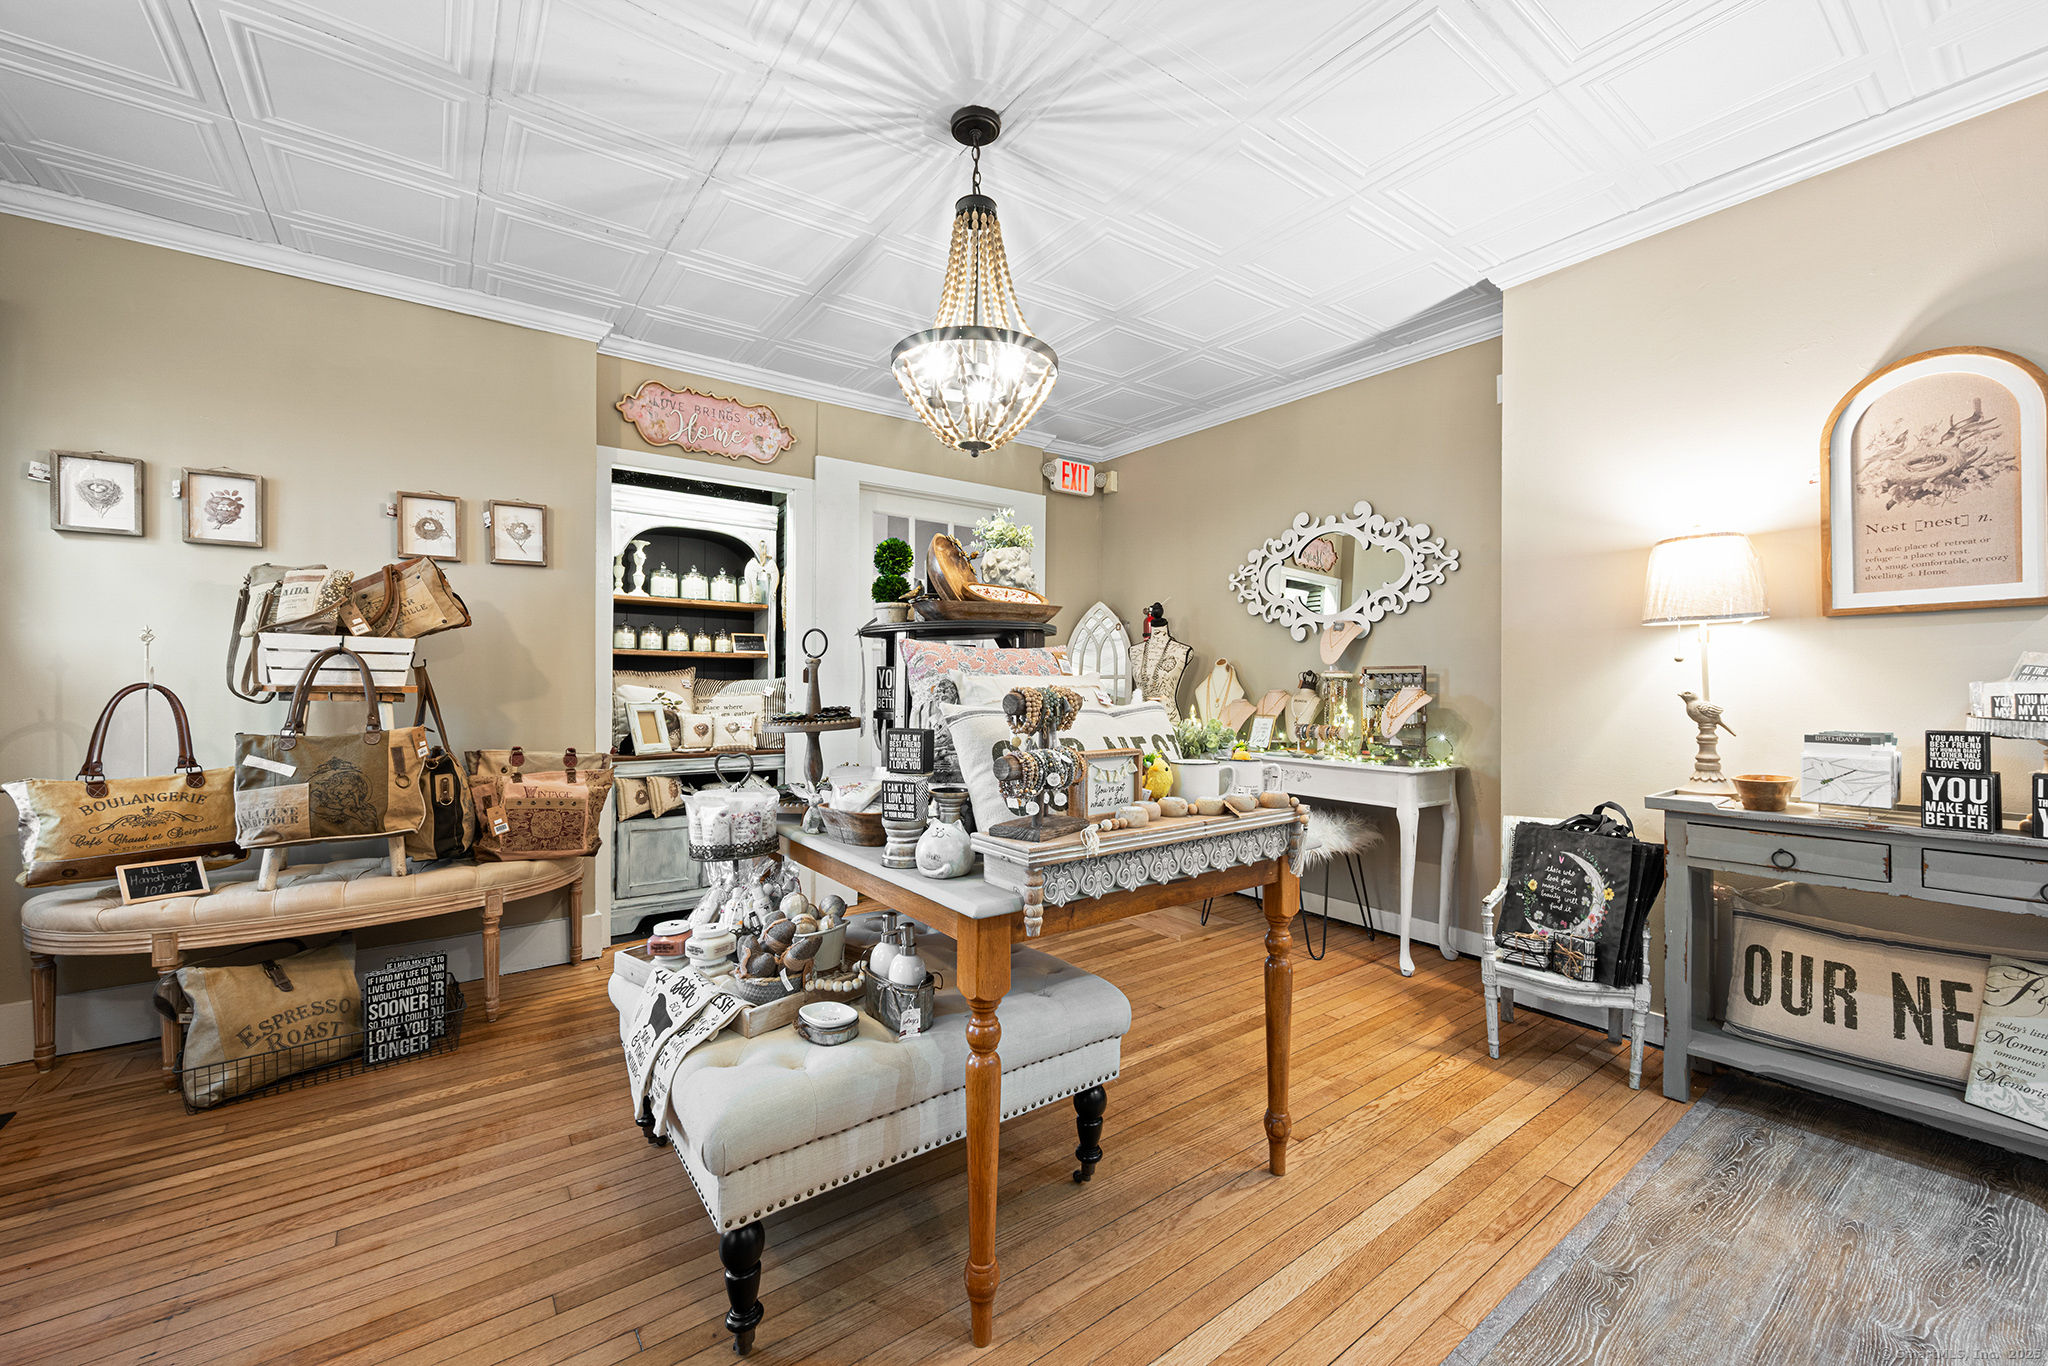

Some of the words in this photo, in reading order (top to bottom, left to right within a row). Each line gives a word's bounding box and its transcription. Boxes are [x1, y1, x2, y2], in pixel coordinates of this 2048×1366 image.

[653, 397, 685, 412] LOVE
[694, 405, 740, 423] BRINGS
[749, 417, 763, 427] US
[669, 410, 746, 447] Home
[1062, 461, 1090, 492] EXIT
[1866, 522, 1907, 535] Nest
[1915, 514, 1969, 532] [nest]
[1978, 514, 1992, 522] n.
[1904, 543, 1928, 552] place
[1945, 538, 1977, 547] retreat
[1910, 552, 1935, 560] place
[1911, 557, 1970, 568] comfortable,
[1986, 554, 2009, 563] cozy
[878, 698, 894, 708] BETT
[2018, 695, 2037, 705] YOU
[2018, 705, 2034, 715] MY
[893, 761, 908, 769] LOVE
[909, 761, 920, 770] YOU
[1936, 760, 1960, 769] LOVE
[1962, 761, 1981, 770] YOU
[887, 783, 902, 792] CAN'T
[905, 784, 914, 792] SAY
[1926, 776, 1988, 804] YOU
[79, 792, 207, 816] BOULANGERIE
[889, 793, 902, 803] LOVE
[903, 794, 914, 803] YOU
[1926, 801, 1963, 814] MAKE
[1968, 804, 1988, 816] ME
[1926, 812, 1988, 830] BETTER
[70, 834, 103, 848] Café
[108, 833, 149, 847] Chaud
[167, 824, 219, 839] Beignets
[130, 872, 187, 886] Handbags
[1545, 874, 1559, 882] look
[144, 883, 166, 895] 10%
[172, 882, 191, 892] OFF
[1541, 889, 1561, 903] beauty
[1542, 883, 1561, 892] magic
[1550, 902, 1563, 910] find
[368, 983, 384, 994] LIVE
[386, 979, 406, 991] OVER
[407, 975, 429, 987] AGAIN
[379, 974, 393, 983] HAD
[394, 972, 404, 980] MY
[406, 969, 419, 978] LIFE
[432, 972, 444, 980] YOU
[372, 991, 397, 1003] WOULD
[398, 988, 414, 997] FIND
[415, 984, 429, 994] YOU
[669, 975, 700, 1008] Bath
[1744, 944, 1858, 1030] OUR
[1891, 971, 1975, 1054] NE
[368, 993, 429, 1020] SOONER
[431, 997, 444, 1006] ULD
[710, 994, 735, 1014] ESH
[235, 998, 351, 1049] ESPRESSO
[368, 1021, 378, 1030] SO
[380, 1016, 399, 1028] THAT
[405, 1010, 429, 1022] COULD
[1996, 1020, 2027, 1034] today's
[266, 1021, 343, 1052] ROAST
[369, 1025, 401, 1046] LOVE
[404, 1019, 429, 1037] YOU
[369, 1034, 429, 1063] LONGER
[1983, 1029, 2048, 1056] Momen
[1993, 1049, 2046, 1069] tomorrow's
[1996, 1062, 2036, 1078] precious
[1976, 1067, 2048, 1100] Memorie
